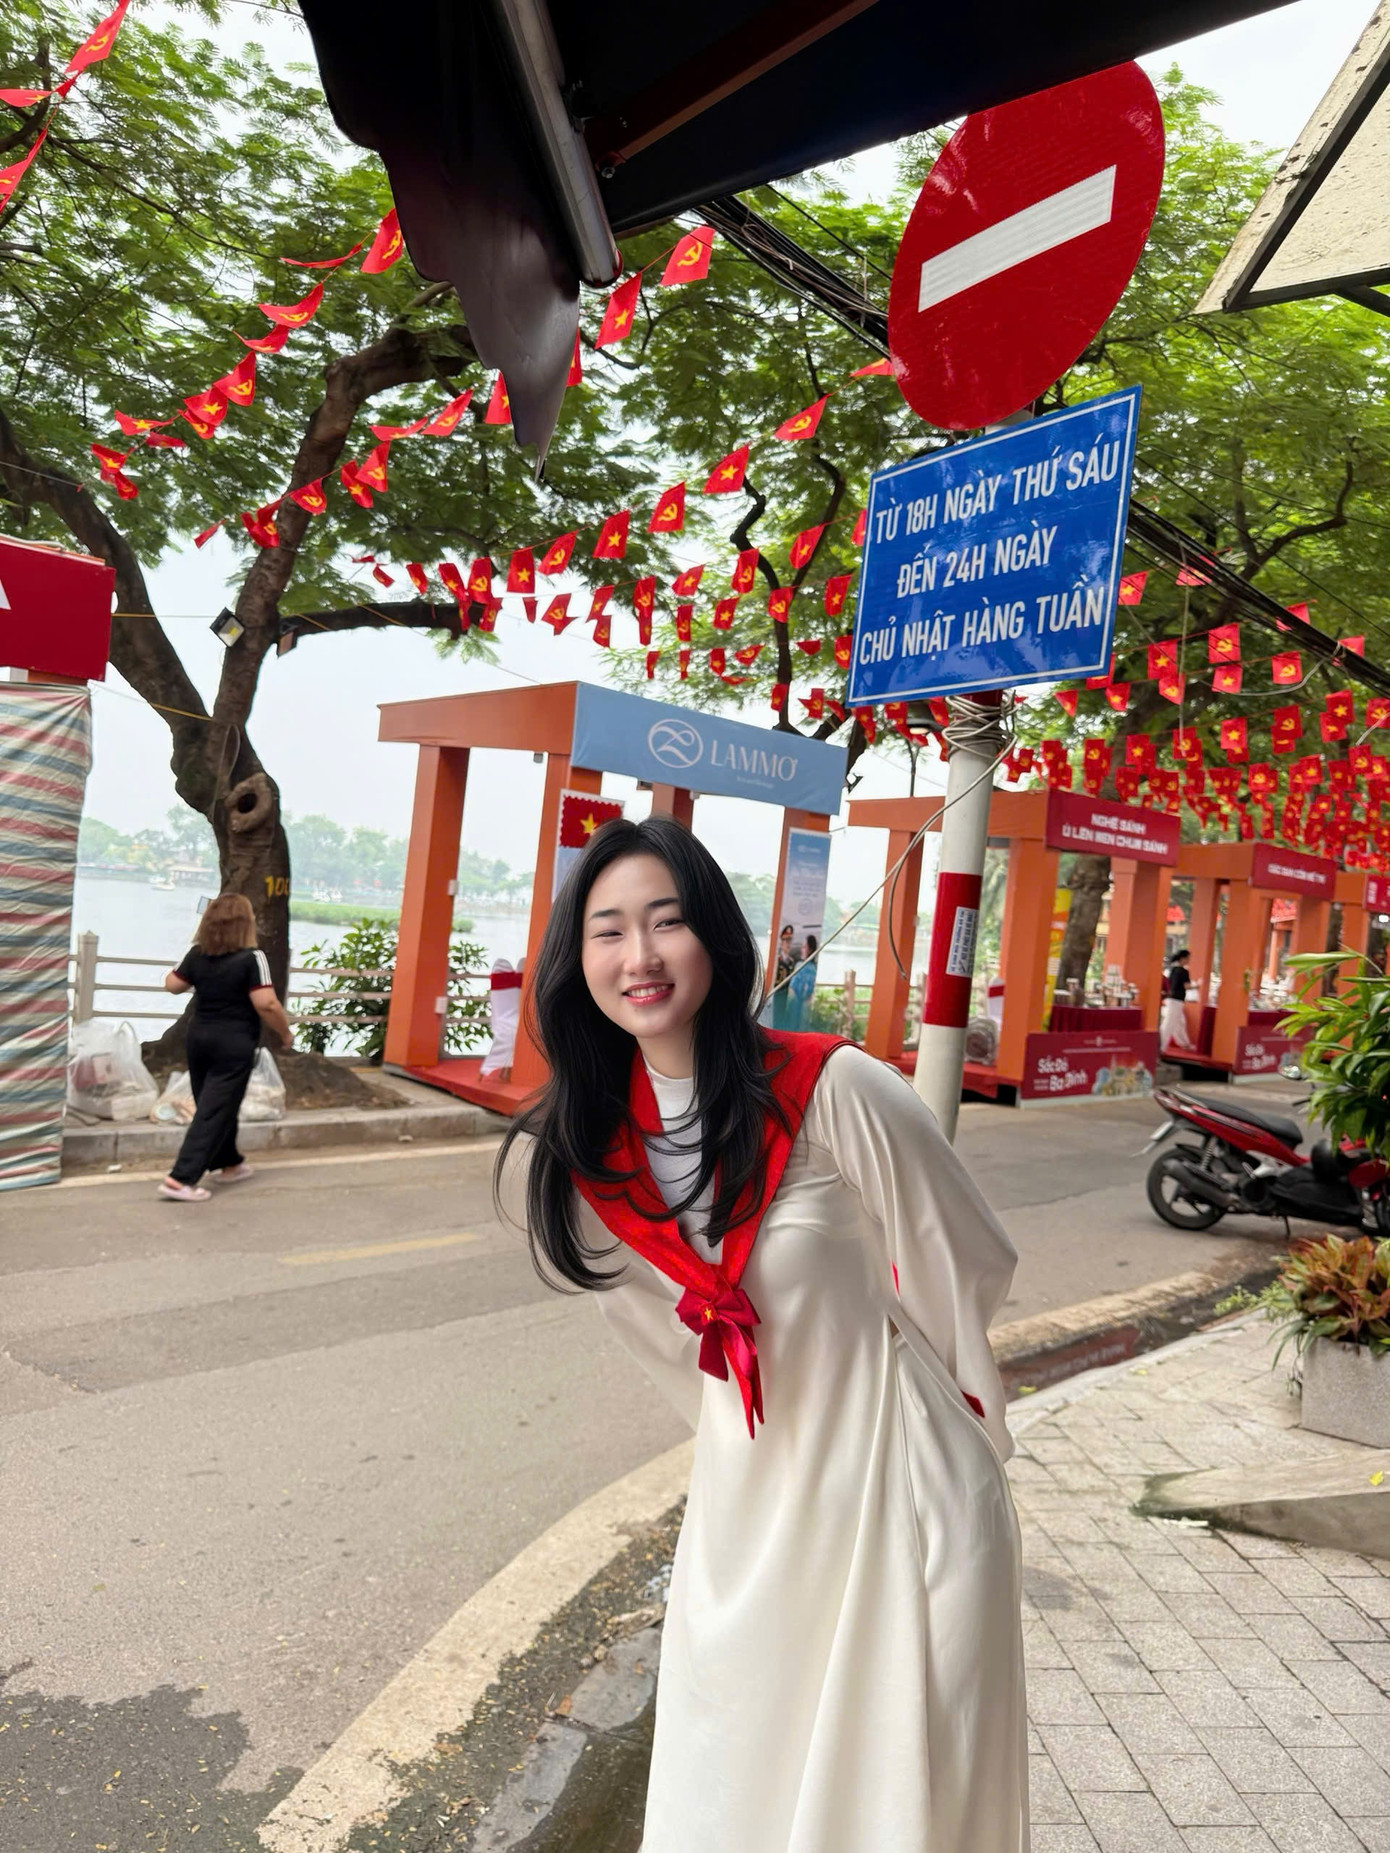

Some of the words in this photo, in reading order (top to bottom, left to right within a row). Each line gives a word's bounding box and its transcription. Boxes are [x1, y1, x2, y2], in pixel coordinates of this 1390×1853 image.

[876, 498, 903, 544] TỪ
[905, 494, 938, 537] 18H
[943, 470, 1002, 524] NGÀY
[1012, 446, 1063, 505] THỨ
[1066, 432, 1120, 491] SÁU
[896, 542, 937, 598] ĐẾN
[943, 542, 988, 588] 24H
[993, 520, 1058, 576] NGÀY
[859, 615, 897, 666] CHỦ
[901, 610, 956, 661] NHẬT
[961, 597, 1025, 648] HÀNG
[1036, 574, 1105, 635] TUẦN
[710, 740, 798, 782] LAMMƠ
